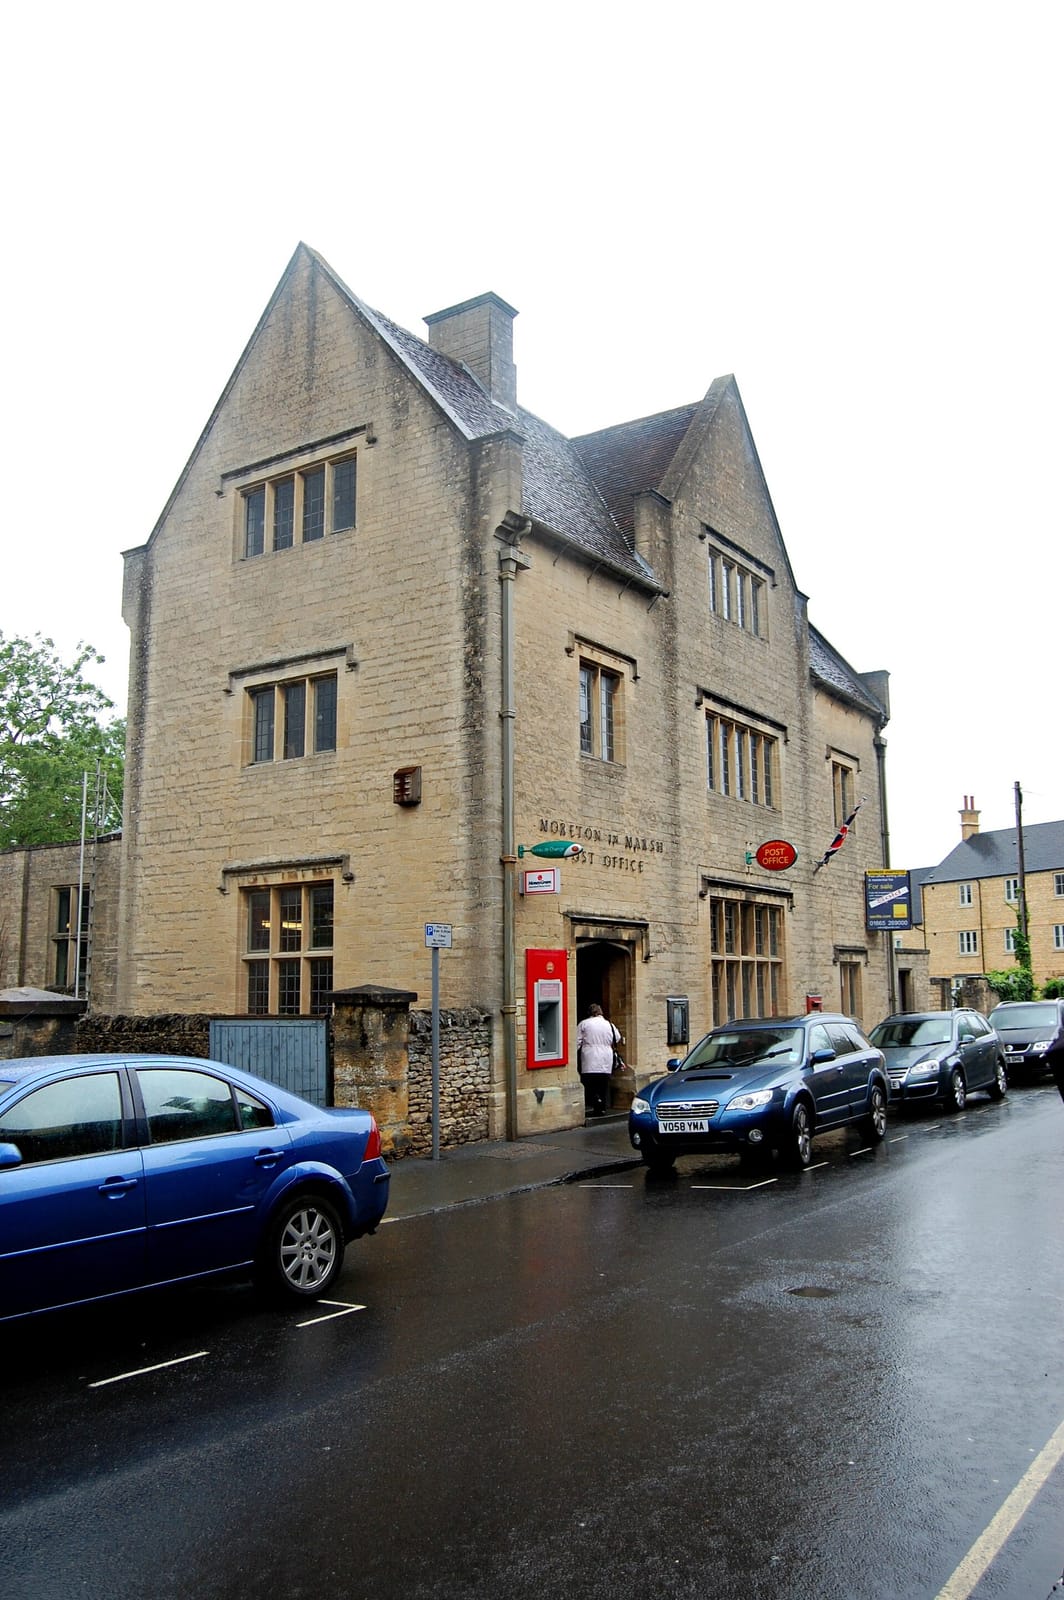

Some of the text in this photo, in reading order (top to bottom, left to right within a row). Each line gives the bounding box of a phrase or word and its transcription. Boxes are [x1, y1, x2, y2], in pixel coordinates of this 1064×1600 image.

[540, 818, 600, 842] MORETON
[625, 835, 664, 853] MARSH
[765, 847, 785, 857] POST
[603, 855, 645, 873] OFFICE
[762, 856, 789, 865] OFFICE
[688, 1121, 705, 1131] YMA
